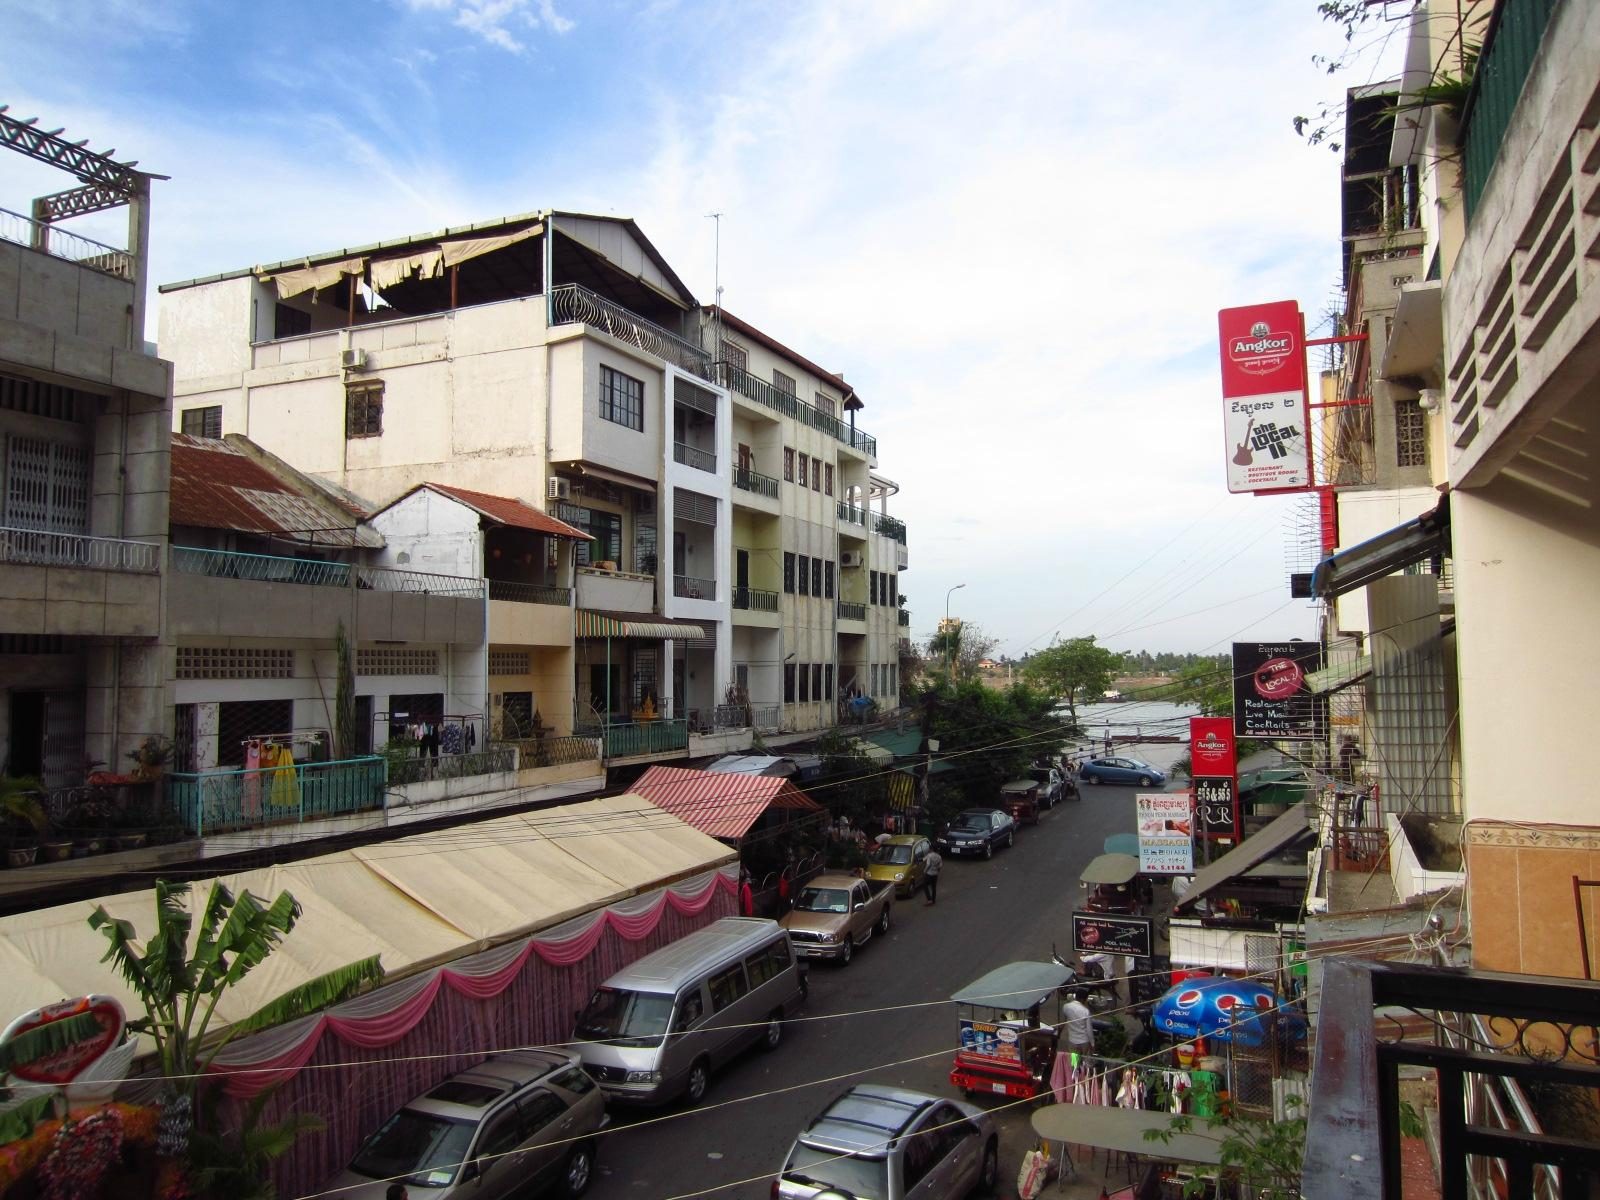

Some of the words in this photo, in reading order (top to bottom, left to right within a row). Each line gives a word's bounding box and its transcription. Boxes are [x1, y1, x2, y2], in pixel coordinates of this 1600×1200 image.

[1234, 338, 1288, 353] Angkor
[1265, 676, 1290, 690] LOCAL
[1245, 720, 1290, 729] Cocktails
[1197, 741, 1226, 750] Angkor
[1142, 839, 1190, 847] MASSAGE
